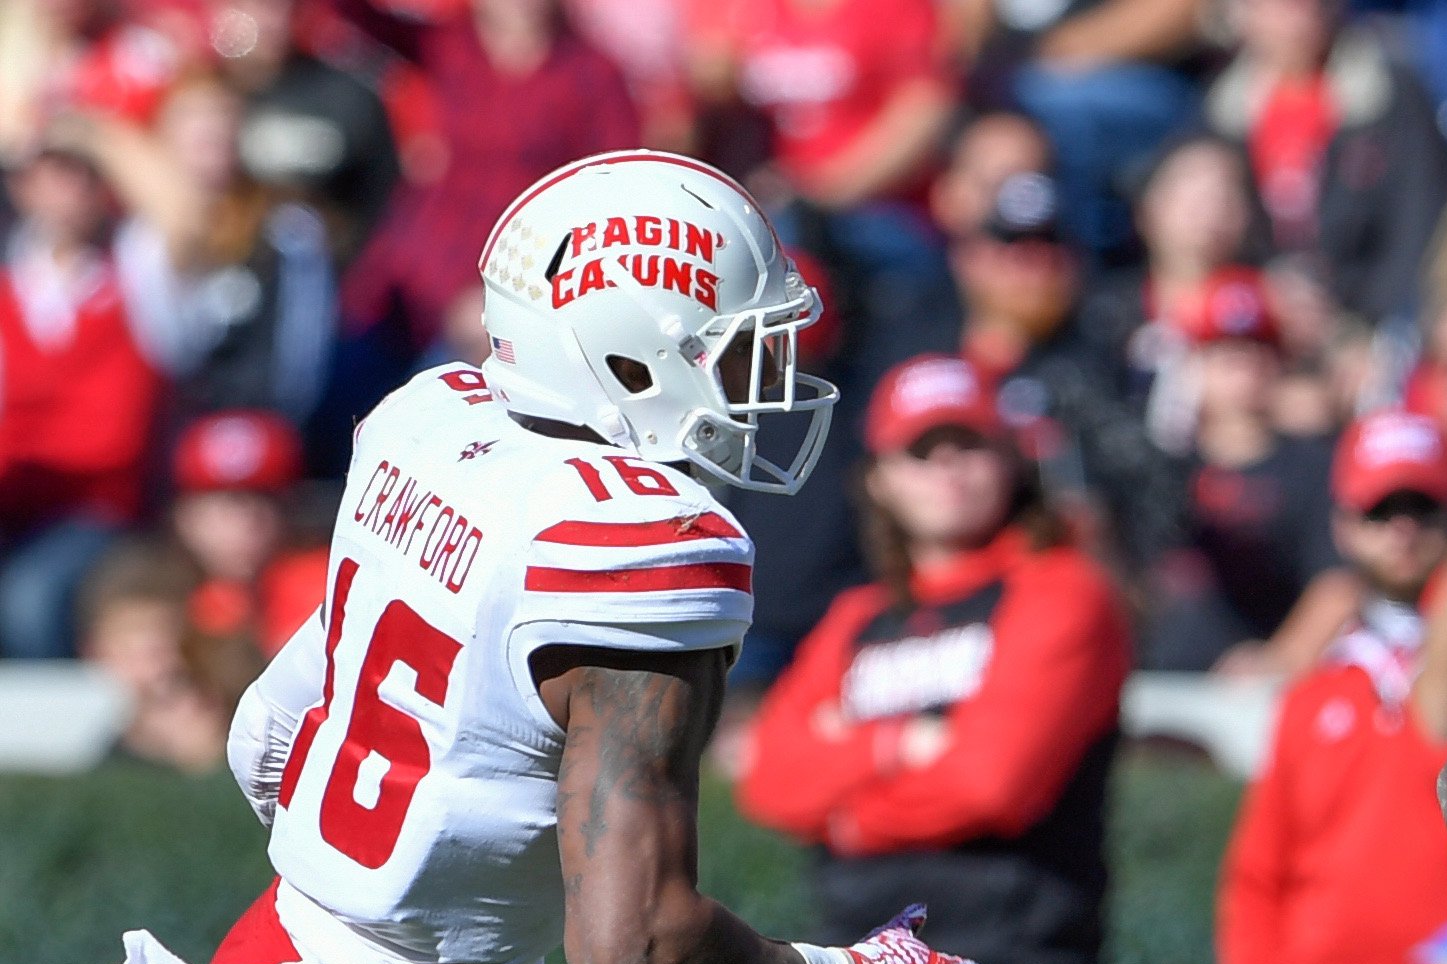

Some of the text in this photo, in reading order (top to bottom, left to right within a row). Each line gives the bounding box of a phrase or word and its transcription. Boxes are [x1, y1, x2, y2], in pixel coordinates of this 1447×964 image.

[353, 460, 484, 595] CRAWFORD
[564, 456, 680, 502] 16
[278, 556, 465, 870] 16
